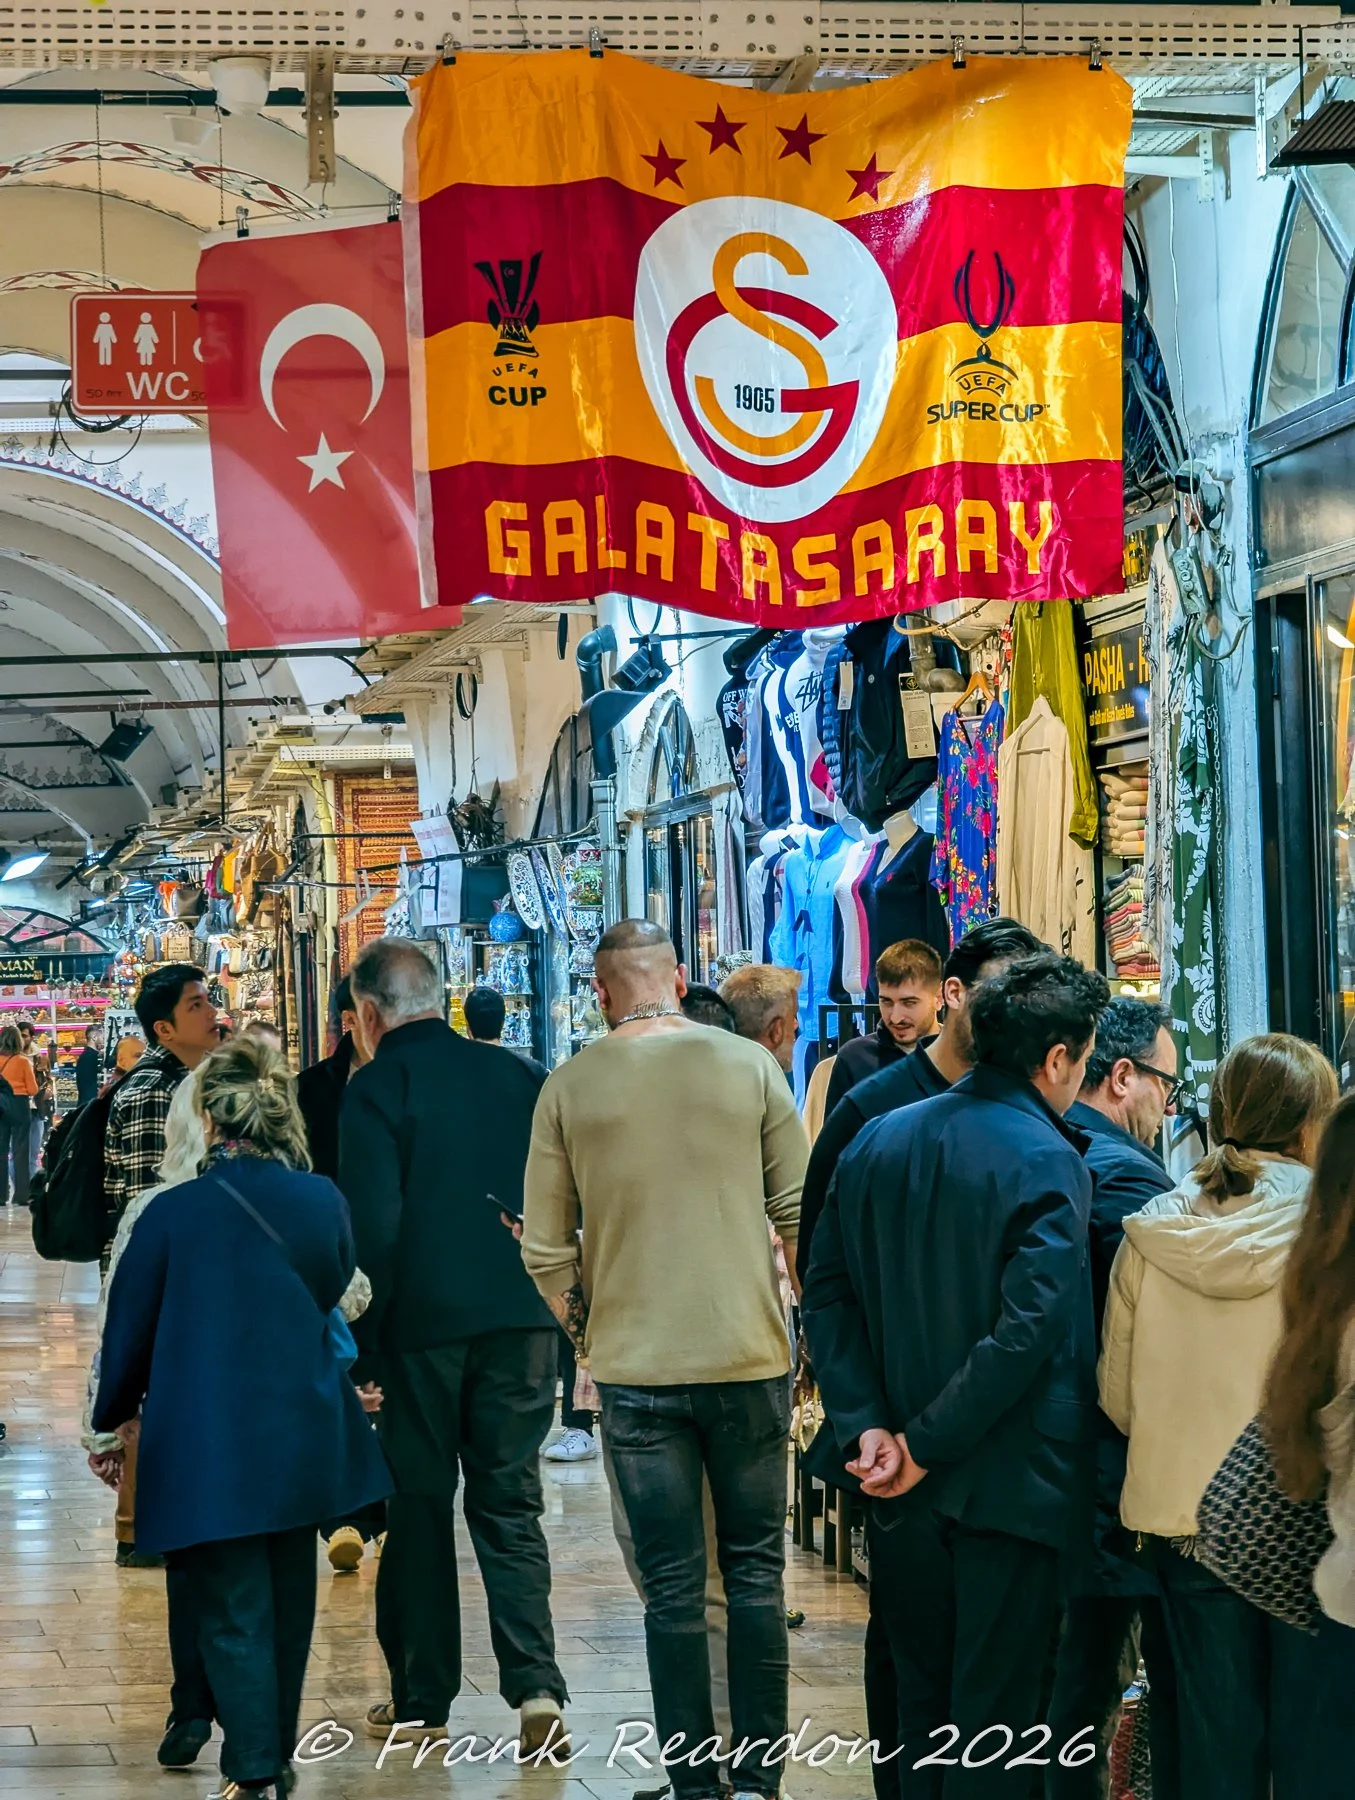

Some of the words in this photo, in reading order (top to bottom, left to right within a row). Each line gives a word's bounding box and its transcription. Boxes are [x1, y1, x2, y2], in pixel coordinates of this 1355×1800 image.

[492, 362, 539, 379] UEFA
[126, 372, 190, 400] WC
[488, 385, 547, 407] CUP
[959, 375, 1006, 394] UEFA
[734, 383, 775, 413] 1905
[484, 494, 1052, 607] GALATASARAY
[1084, 644, 1125, 696] PASHA
[722, 691, 737, 702] OFF
